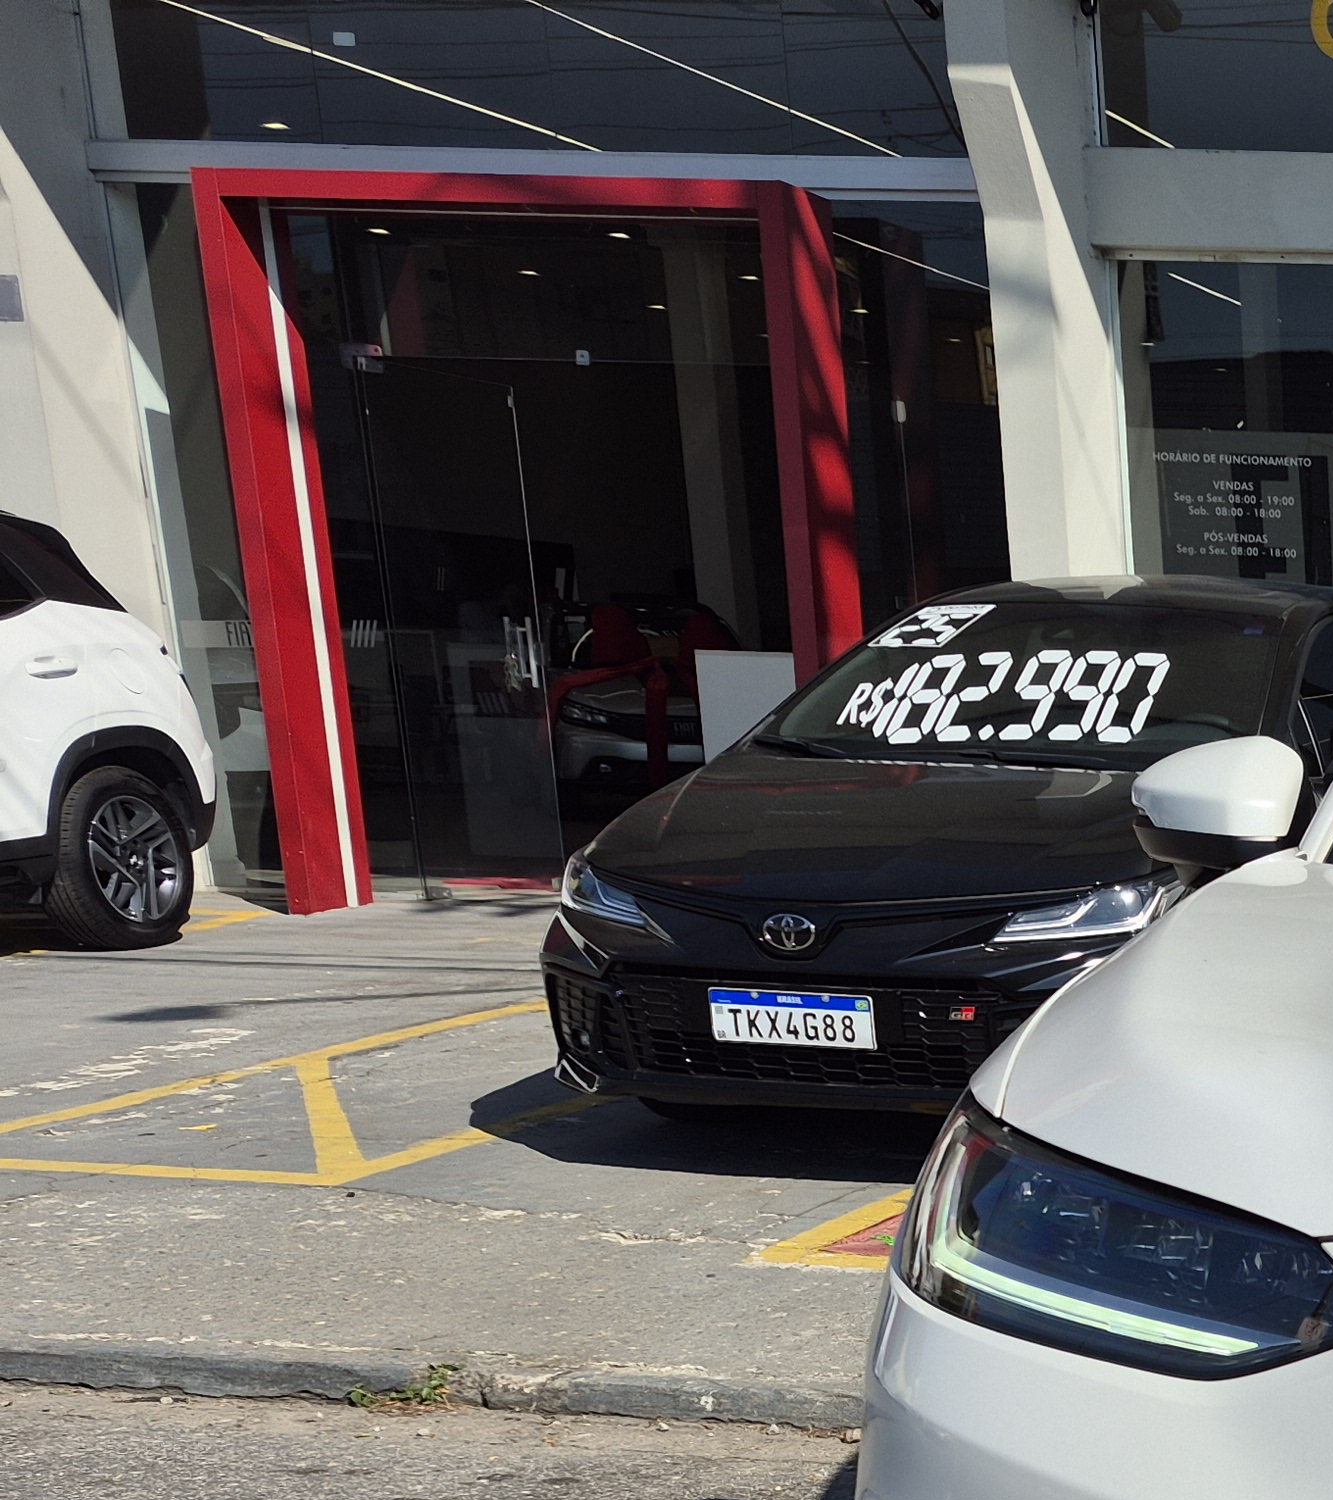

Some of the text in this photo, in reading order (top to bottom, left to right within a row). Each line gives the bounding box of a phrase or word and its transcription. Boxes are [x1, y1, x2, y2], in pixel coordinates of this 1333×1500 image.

[1152, 450, 1312, 467] HORÁRIO DE FUNCIONAMENTO
[1213, 480, 1254, 491] VENDAS
[1173, 492, 1195, 504] Seg.
[1206, 493, 1225, 503] Sex.
[1228, 494, 1257, 505] 08:00
[1267, 496, 1295, 506] 19:00
[1215, 507, 1243, 517] 08:00
[1254, 508, 1281, 519] 18:00
[1204, 530, 1268, 543] PÓS-VENDAS
[1176, 544, 1197, 556] Seg.
[1209, 545, 1228, 555] Sex.
[1231, 546, 1258, 557] 08:00
[1269, 548, 1297, 558] 18:00
[225, 621, 251, 646] FIA
[880, 614, 974, 648] 25
[836, 650, 1170, 744] R$ 182.990
[728, 1008, 856, 1042] TKX4G88
